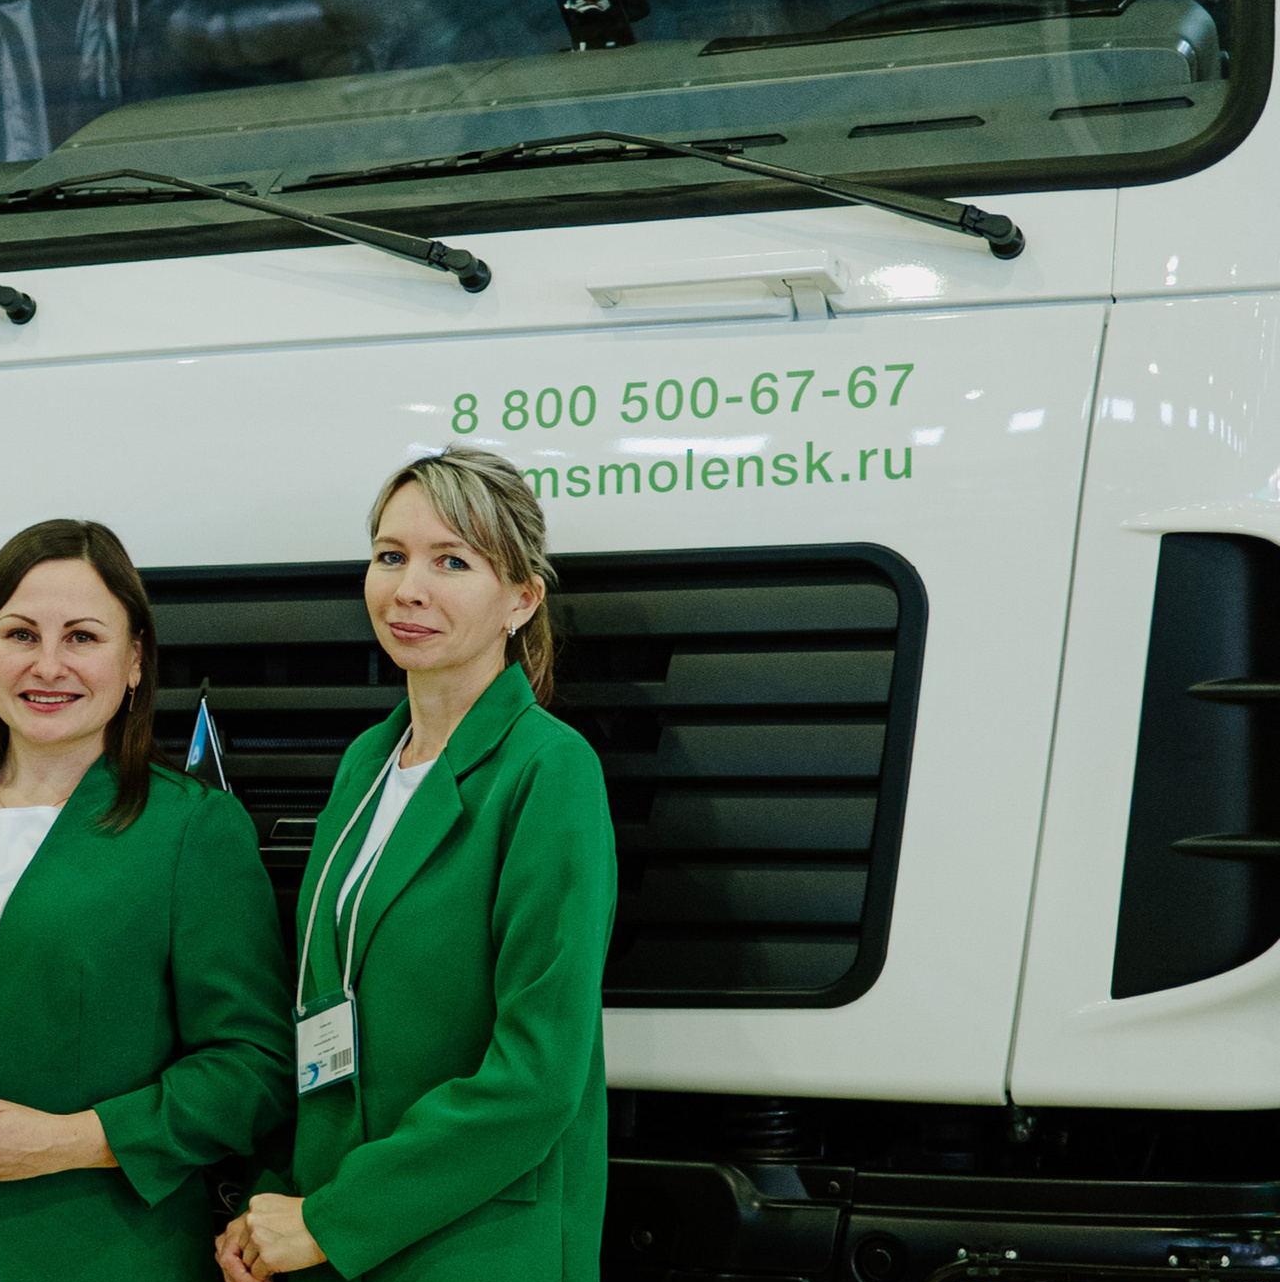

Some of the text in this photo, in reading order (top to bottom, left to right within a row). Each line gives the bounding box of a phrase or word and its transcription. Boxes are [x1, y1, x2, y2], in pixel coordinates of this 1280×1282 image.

[451, 363, 915, 434] 8 800 500-67-67
[520, 442, 913, 499] msmolensk.ru
